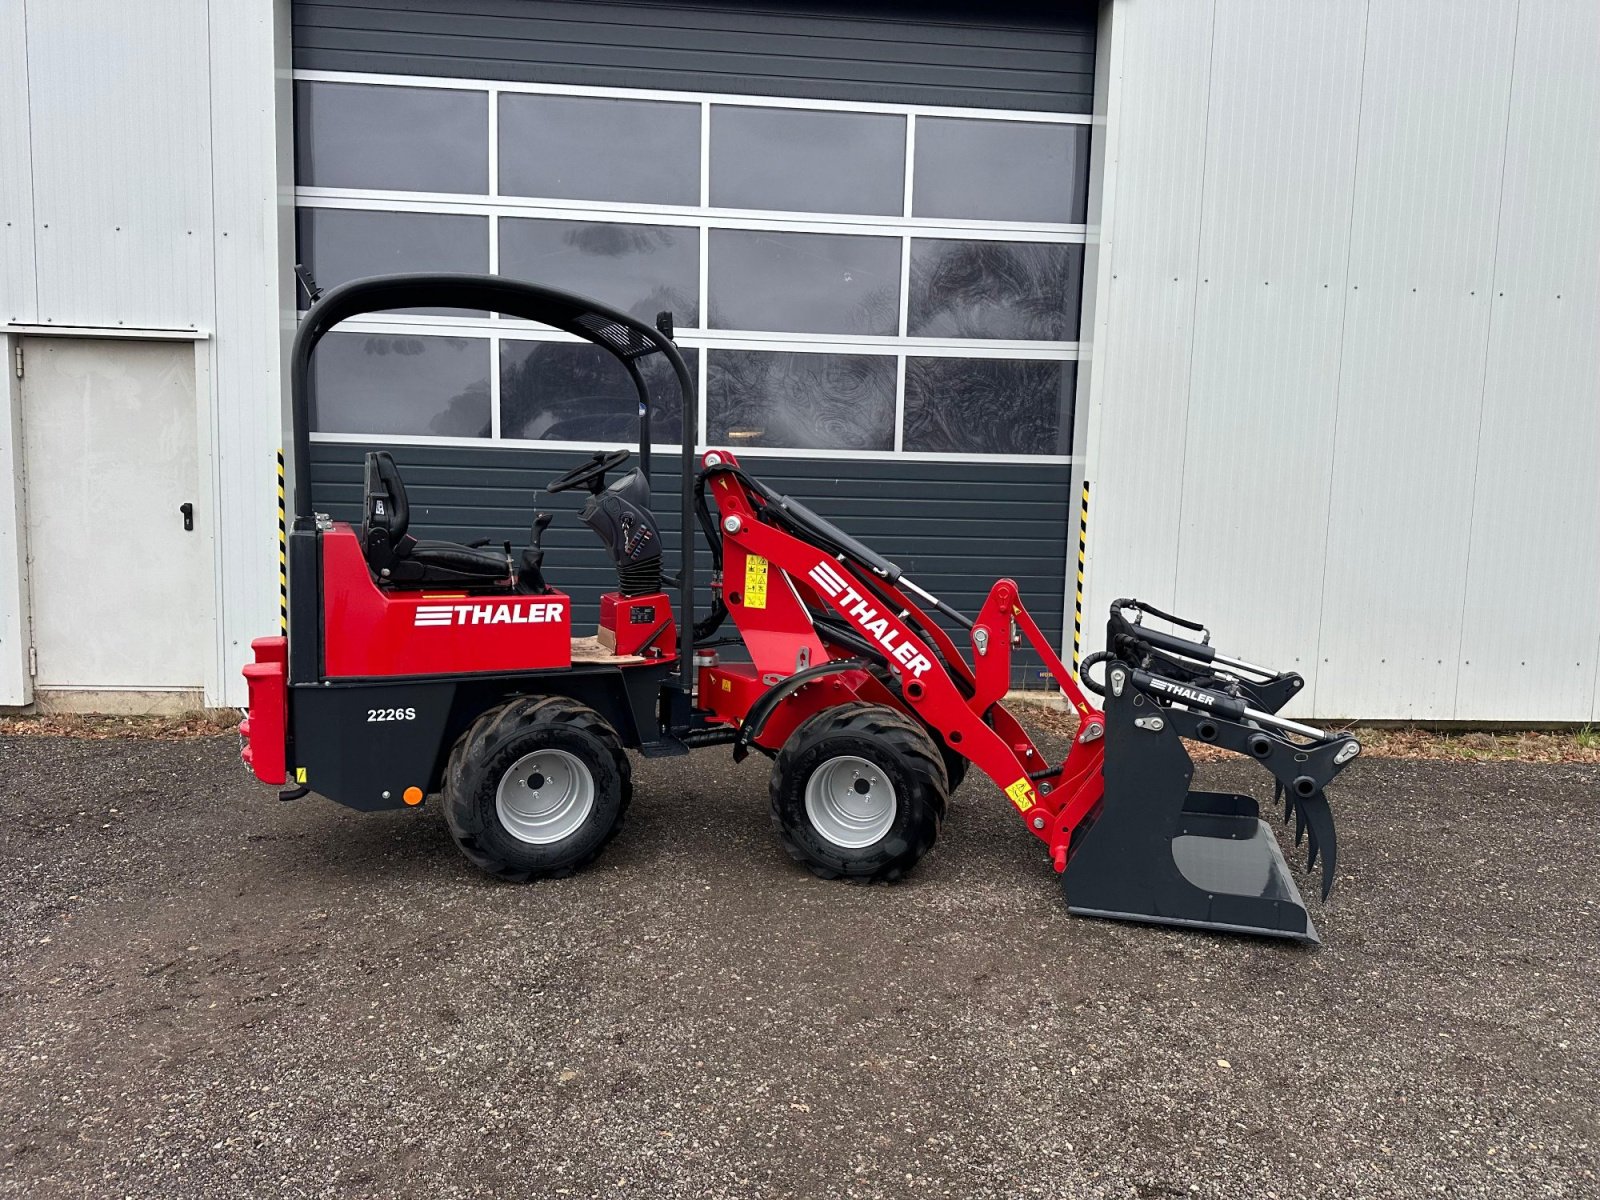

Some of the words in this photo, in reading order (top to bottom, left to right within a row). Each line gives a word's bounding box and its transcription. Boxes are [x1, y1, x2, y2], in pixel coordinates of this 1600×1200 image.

[453, 603, 563, 625] THALER
[839, 586, 931, 678] THALER
[1166, 683, 1215, 706] THALER
[367, 707, 416, 722] 2226S
